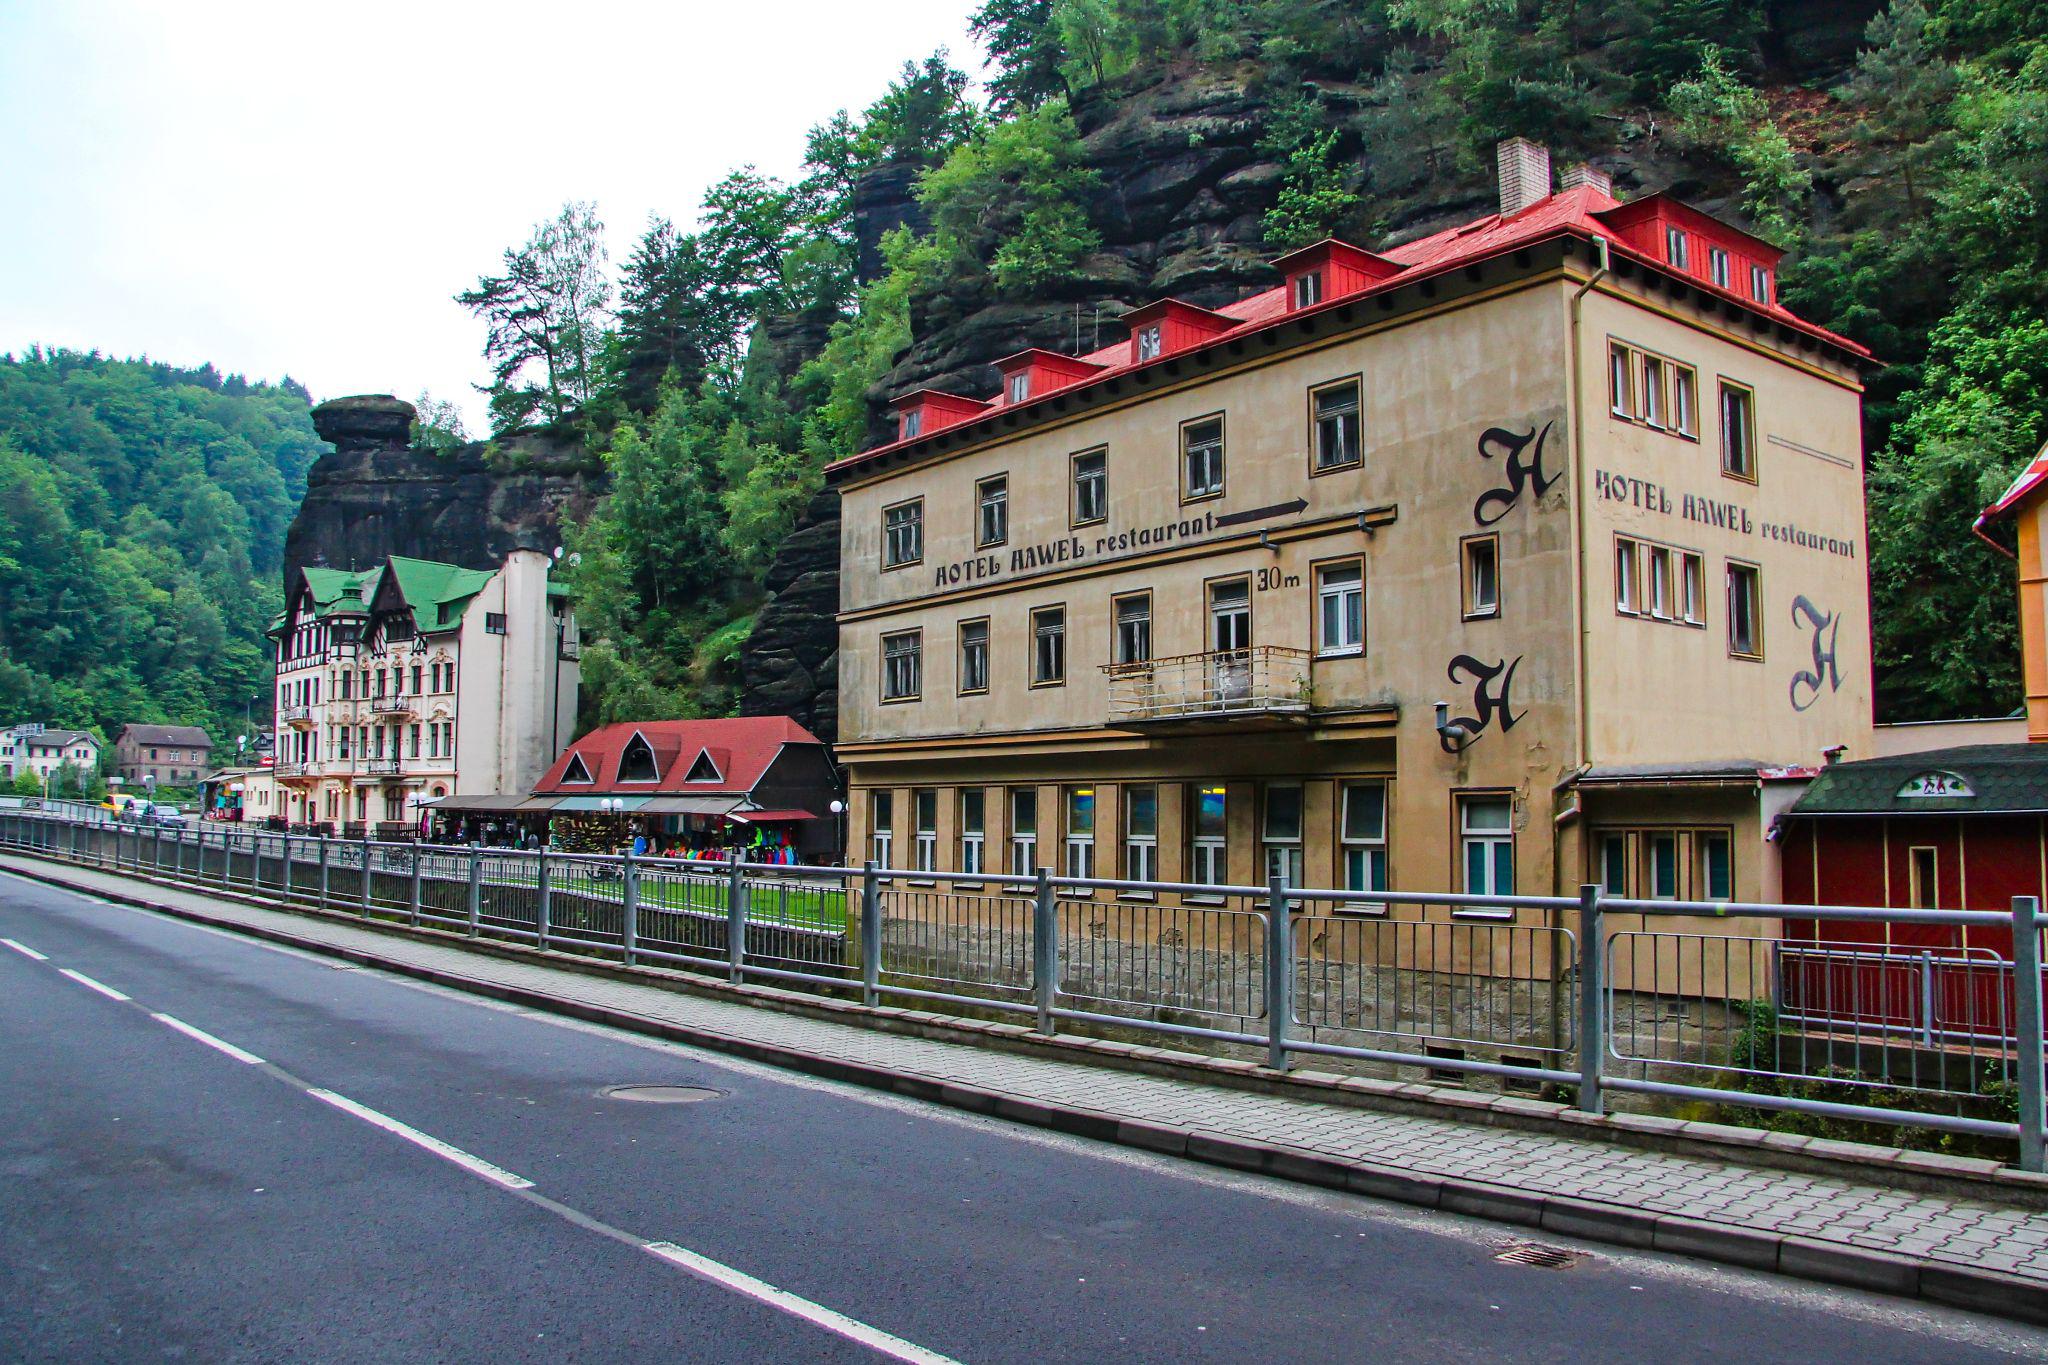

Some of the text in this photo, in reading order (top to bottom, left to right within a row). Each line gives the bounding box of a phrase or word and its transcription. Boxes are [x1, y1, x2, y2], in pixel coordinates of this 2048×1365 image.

[935, 511, 1213, 587] HOTEL HAWEL restaurant
[1595, 468, 1855, 559] HOTEL HAWEL restaurant
